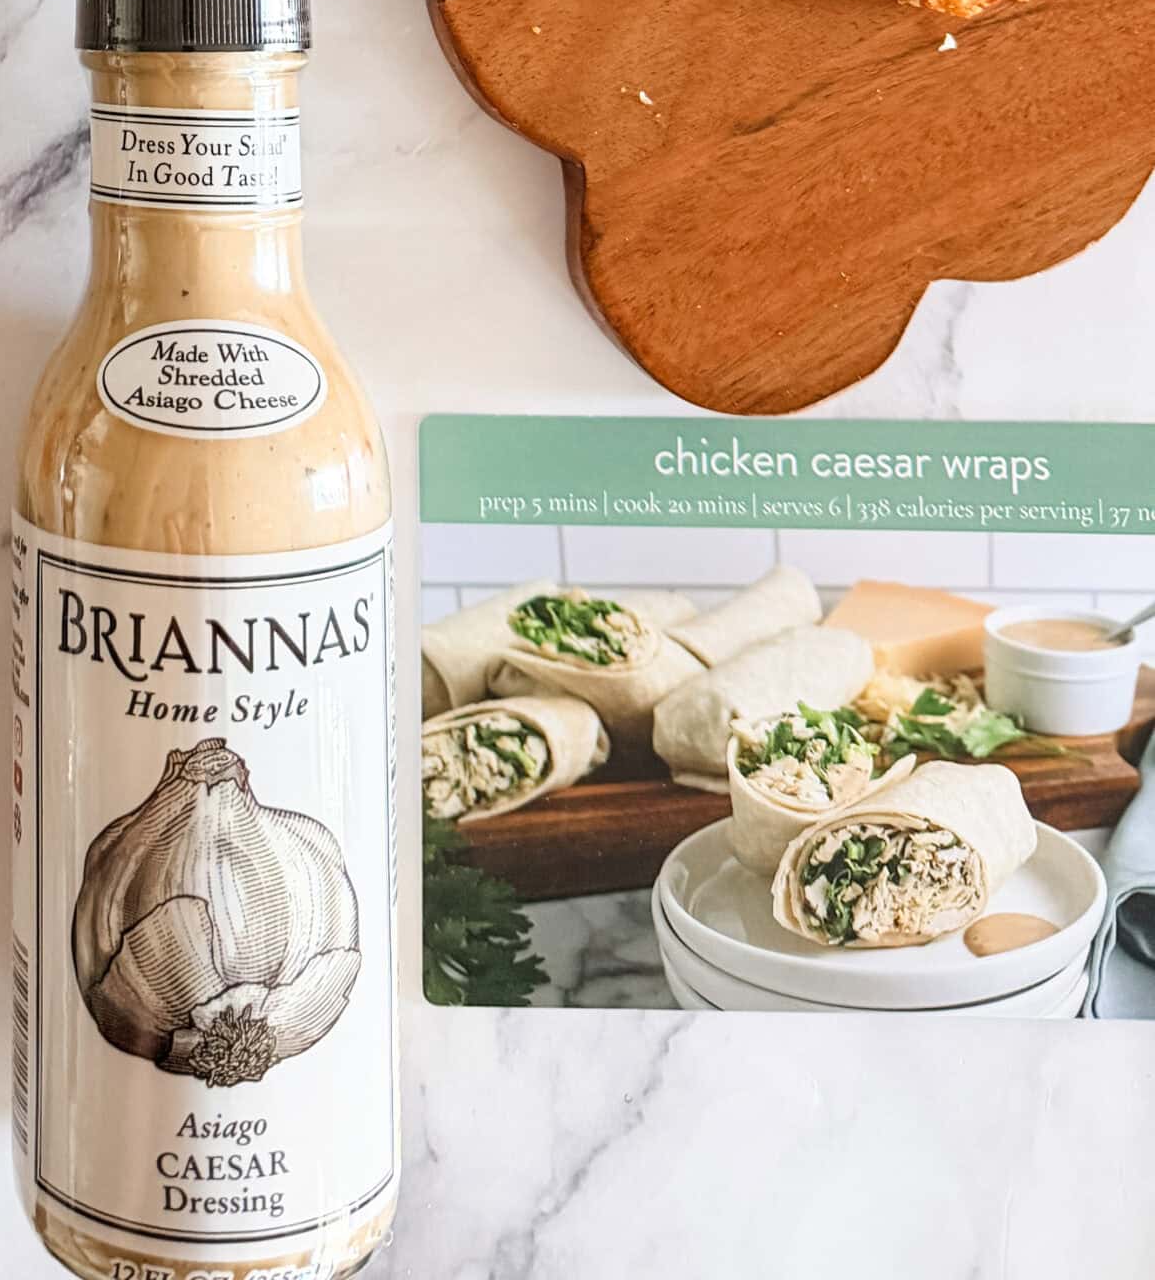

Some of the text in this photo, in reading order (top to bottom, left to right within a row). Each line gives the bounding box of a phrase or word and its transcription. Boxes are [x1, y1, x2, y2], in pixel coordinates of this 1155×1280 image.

[121, 130, 175, 154] Dress
[181, 134, 232, 157] Your
[127, 161, 147, 183] In
[153, 164, 214, 187] Good
[151, 340, 269, 363] Made With
[158, 365, 265, 386] Shredded
[124, 386, 299, 412] Asiago Cheese
[654, 436, 1051, 495] chicken caesar wraps
[479, 494, 526, 519] prep
[532, 497, 542, 518] 5
[549, 493, 598, 513] mins
[614, 490, 662, 514] cook
[668, 498, 692, 514] 20
[698, 494, 748, 515] mins
[763, 499, 823, 517] serves
[828, 496, 841, 518] 6
[856, 498, 891, 523] 338
[896, 496, 974, 520] calories
[980, 502, 1014, 526] per
[1019, 500, 1094, 528] serving
[1108, 506, 1131, 528] 37
[58, 588, 371, 682] BRIANNAS
[125, 689, 309, 729] Home Style
[176, 1112, 268, 1146] Asiago
[155, 1150, 289, 1181] CAESAR
[162, 1185, 285, 1216] Dressing
